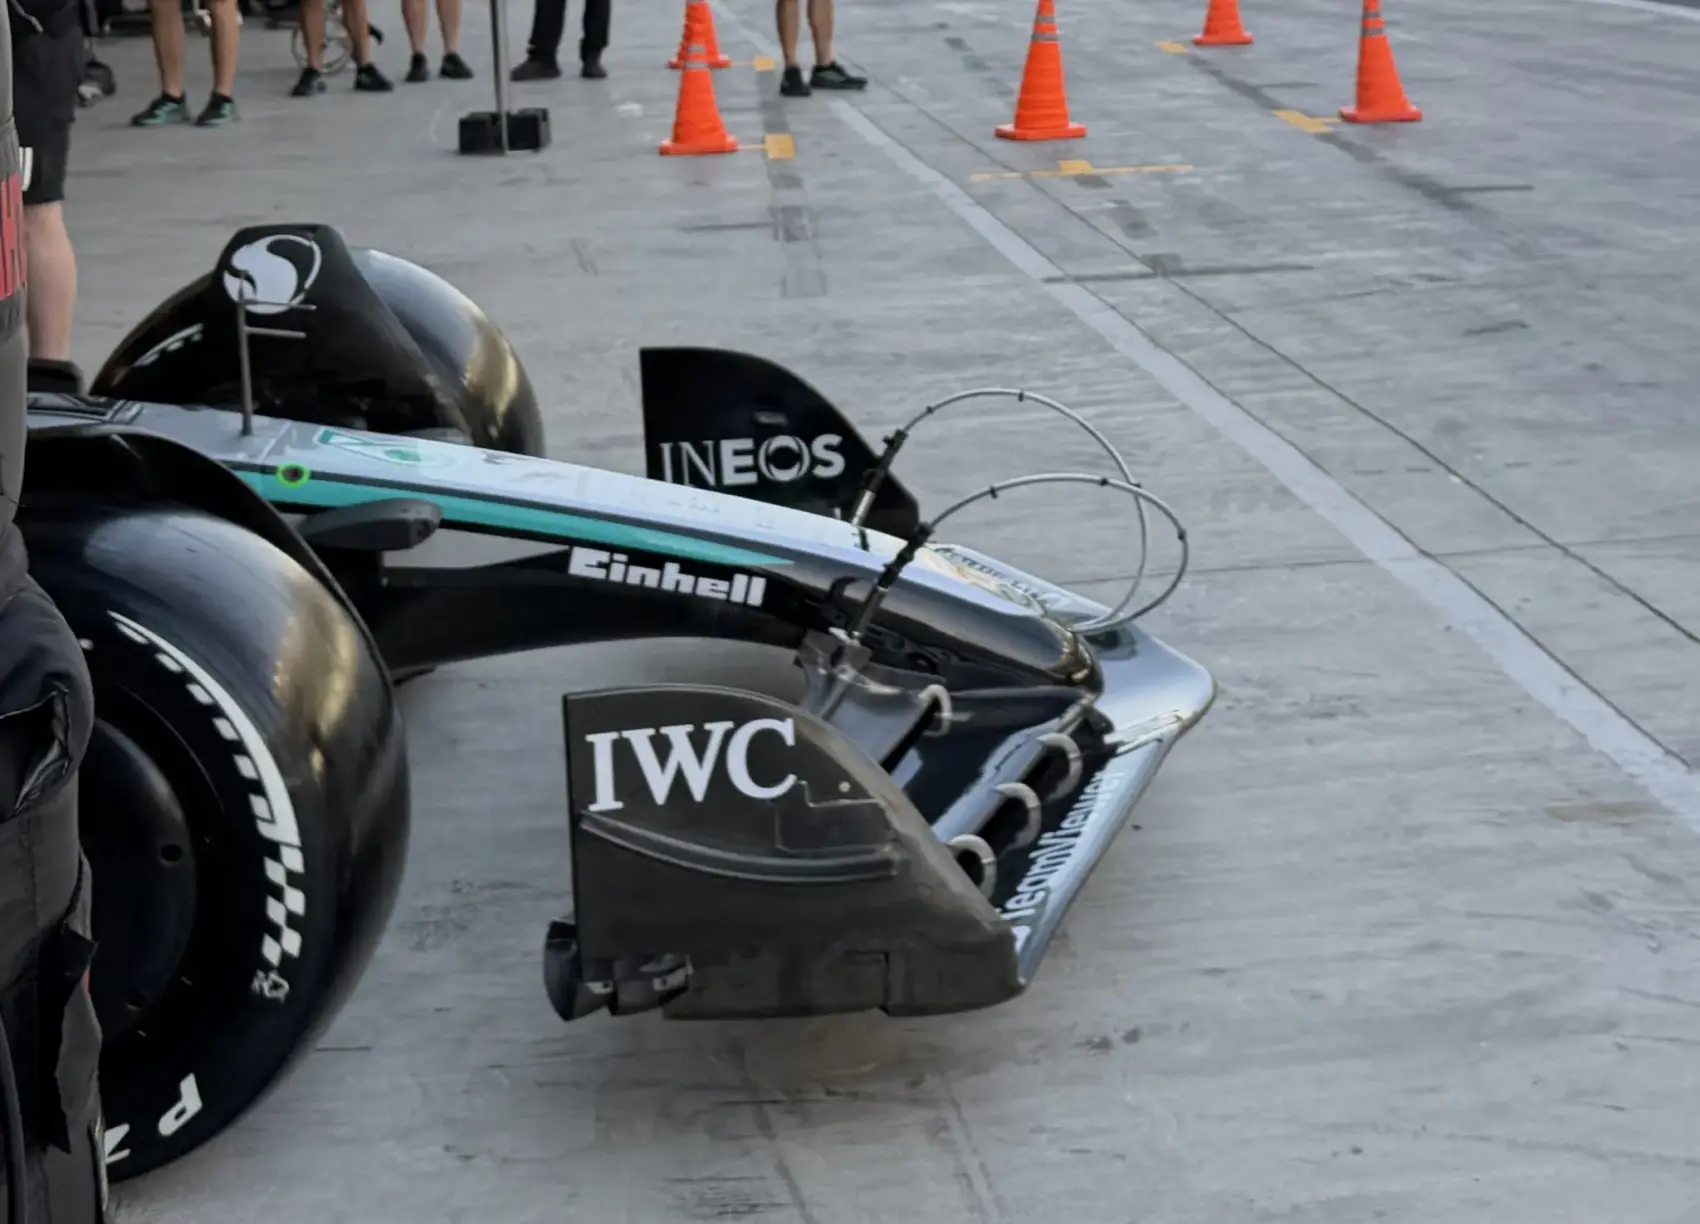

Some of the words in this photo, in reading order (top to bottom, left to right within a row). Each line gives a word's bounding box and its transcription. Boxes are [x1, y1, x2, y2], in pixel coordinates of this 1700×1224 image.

[659, 434, 846, 487] INEOS
[568, 546, 767, 607] Einhell
[585, 718, 797, 812] IWC
